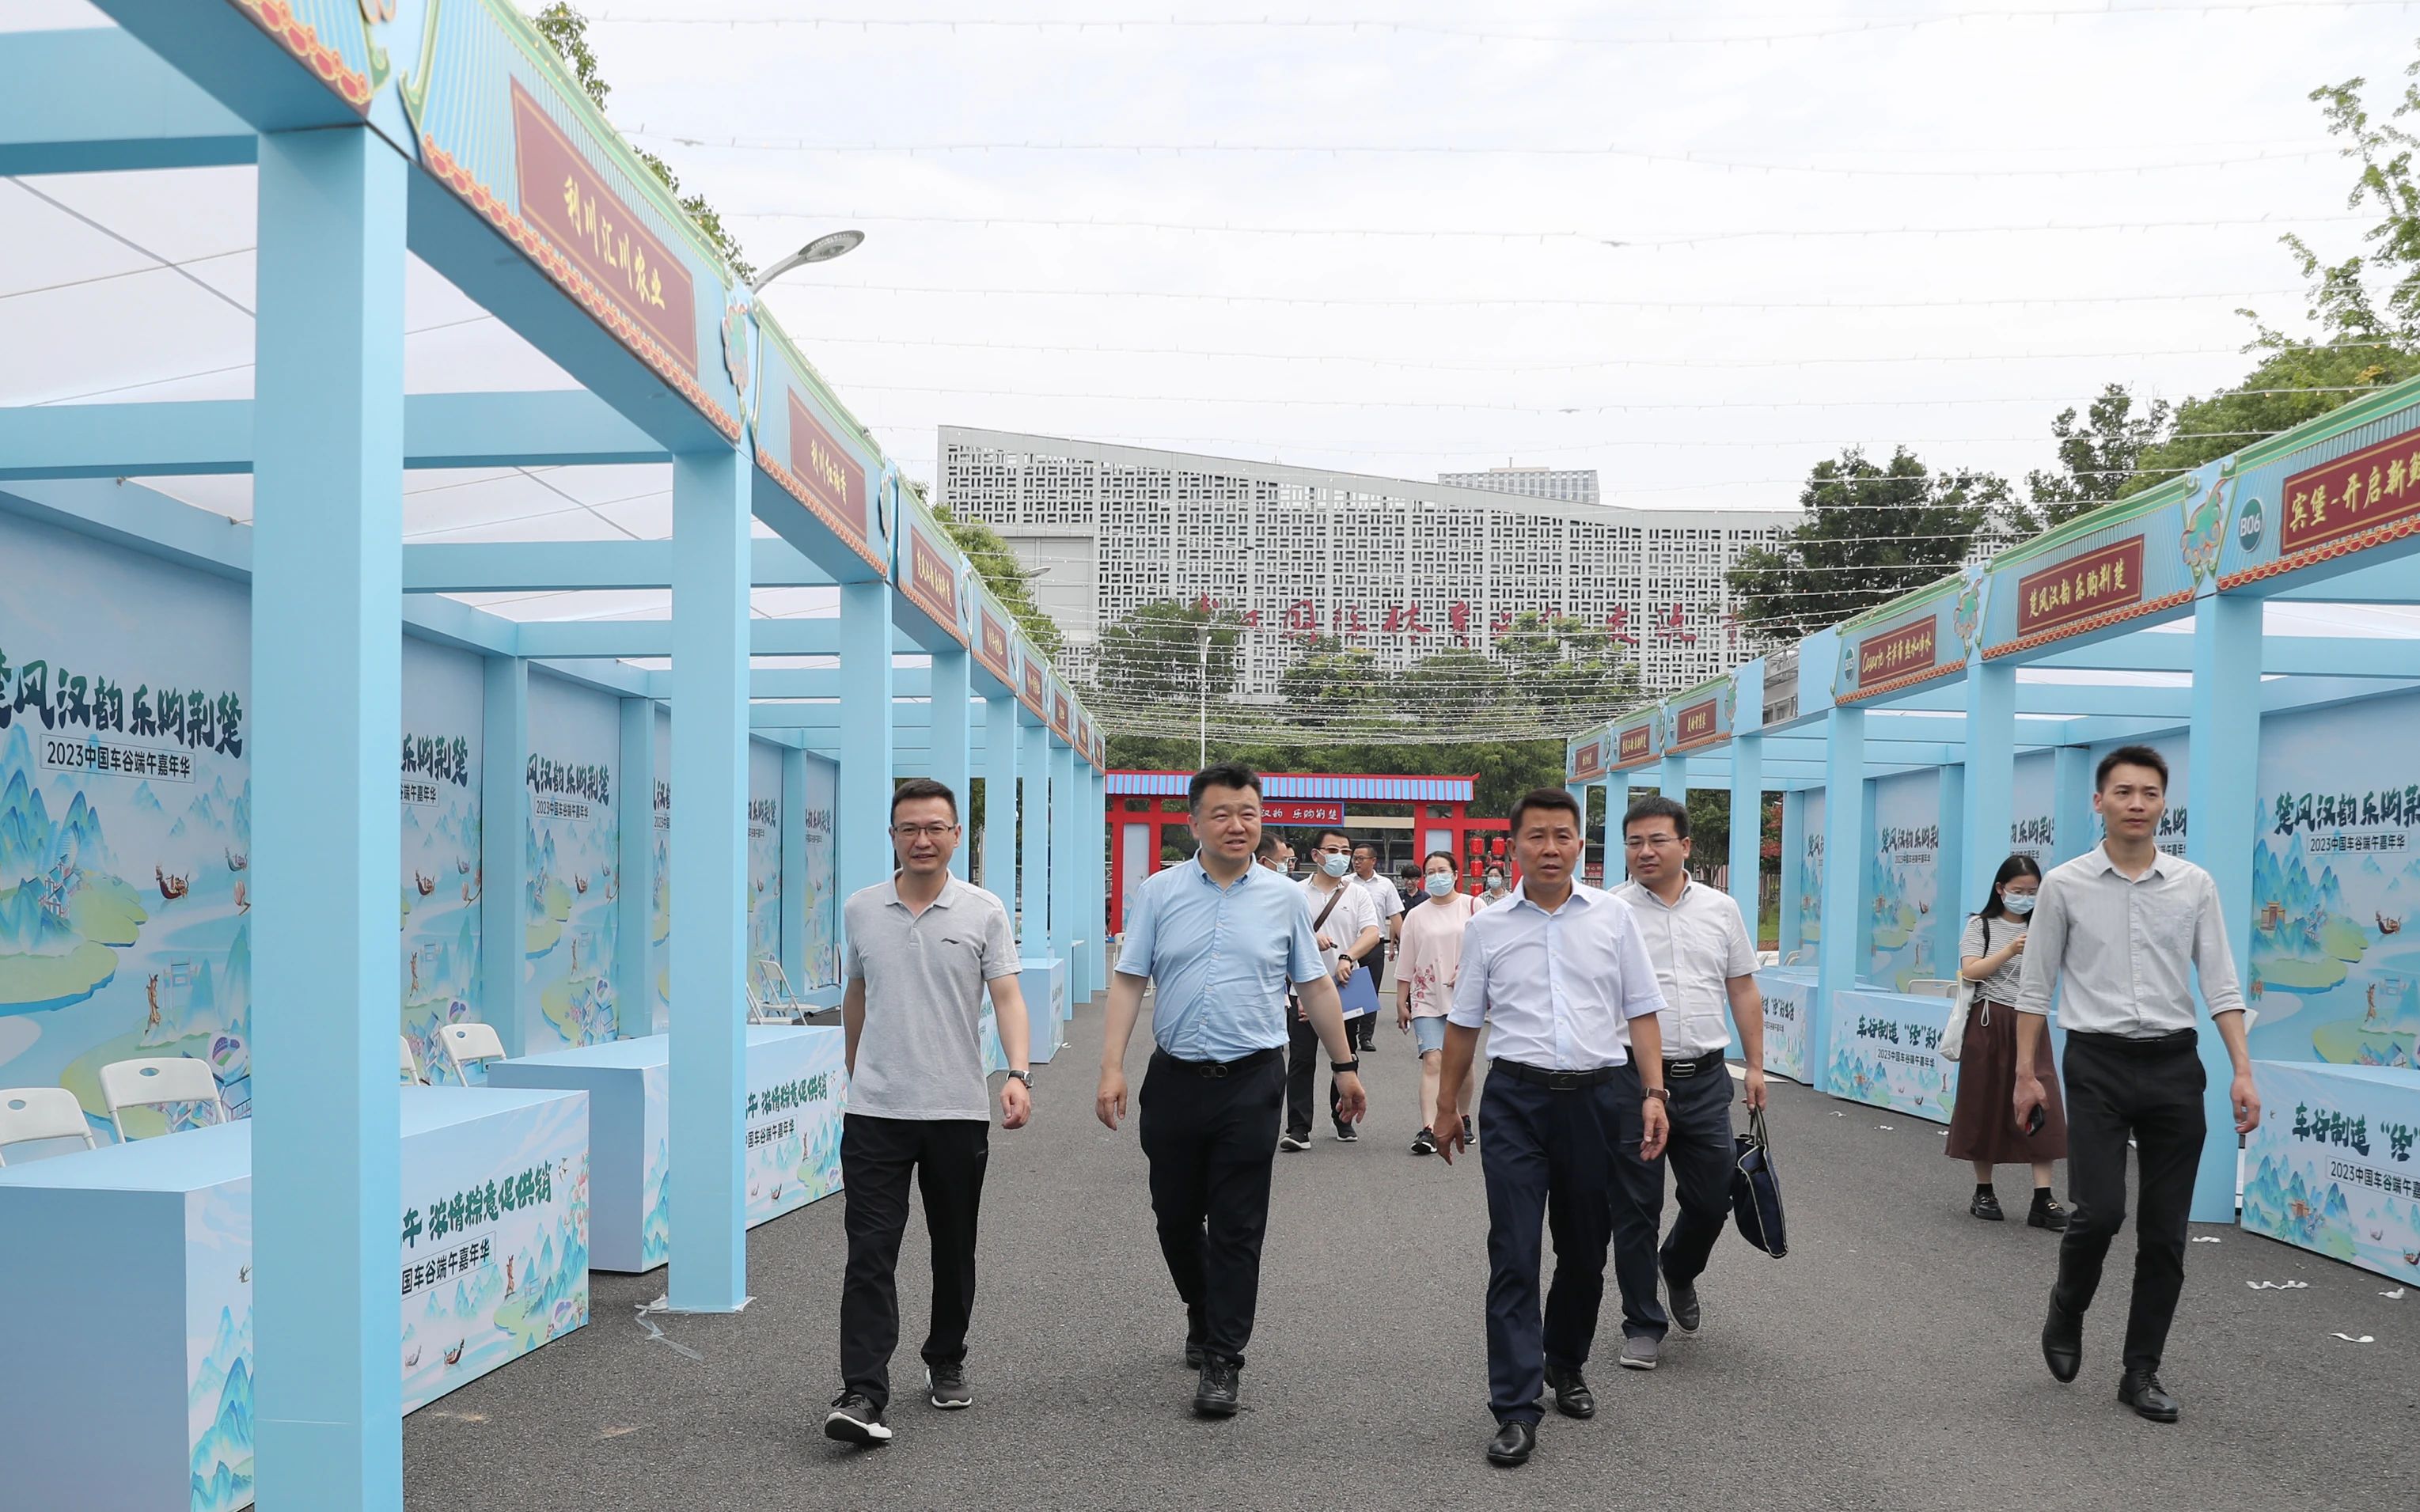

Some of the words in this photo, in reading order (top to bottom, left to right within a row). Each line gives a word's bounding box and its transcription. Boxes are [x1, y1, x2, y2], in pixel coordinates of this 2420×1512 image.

[2239, 513, 2261, 538] B06
[47, 741, 191, 779] 2023中国车谷端午嘉年华
[537, 801, 590, 819] 2023中国车谷端午嘉年华
[2310, 834, 2406, 852] 2023中国车谷端午嘉年华
[1877, 1048, 1936, 1068] 2023中国车谷端午嘉年华
[745, 1118, 795, 1149] 国车谷端午嘉年华
[2292, 1101, 2371, 1157] 车谷制造
[428, 1159, 552, 1241] 浓情粽意促供销
[401, 1237, 491, 1295] 国车谷端午嘉年华
